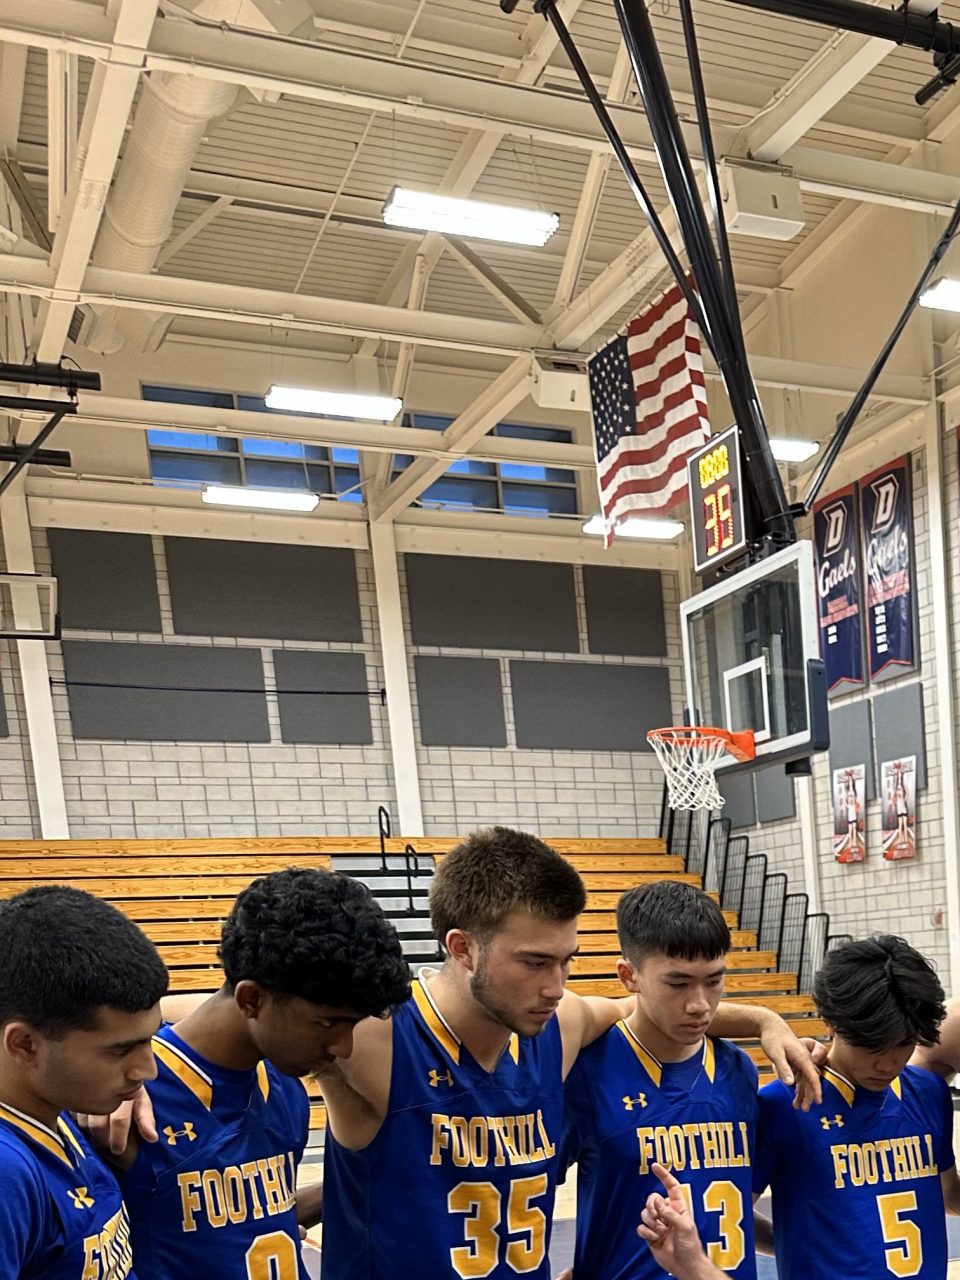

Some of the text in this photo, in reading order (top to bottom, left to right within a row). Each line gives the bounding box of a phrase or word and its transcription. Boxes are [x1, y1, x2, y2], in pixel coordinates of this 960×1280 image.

[703, 484, 733, 556] 35
[822, 501, 848, 558] D
[871, 474, 899, 534] D
[818, 548, 856, 598] Gaels
[867, 524, 908, 576] Gaels
[430, 1109, 556, 1168] FOOTHILL
[830, 1134, 938, 1189] FOOTHILL
[447, 1173, 549, 1280] 35
[667, 1180, 745, 1272] 3
[876, 1190, 923, 1278] 5
